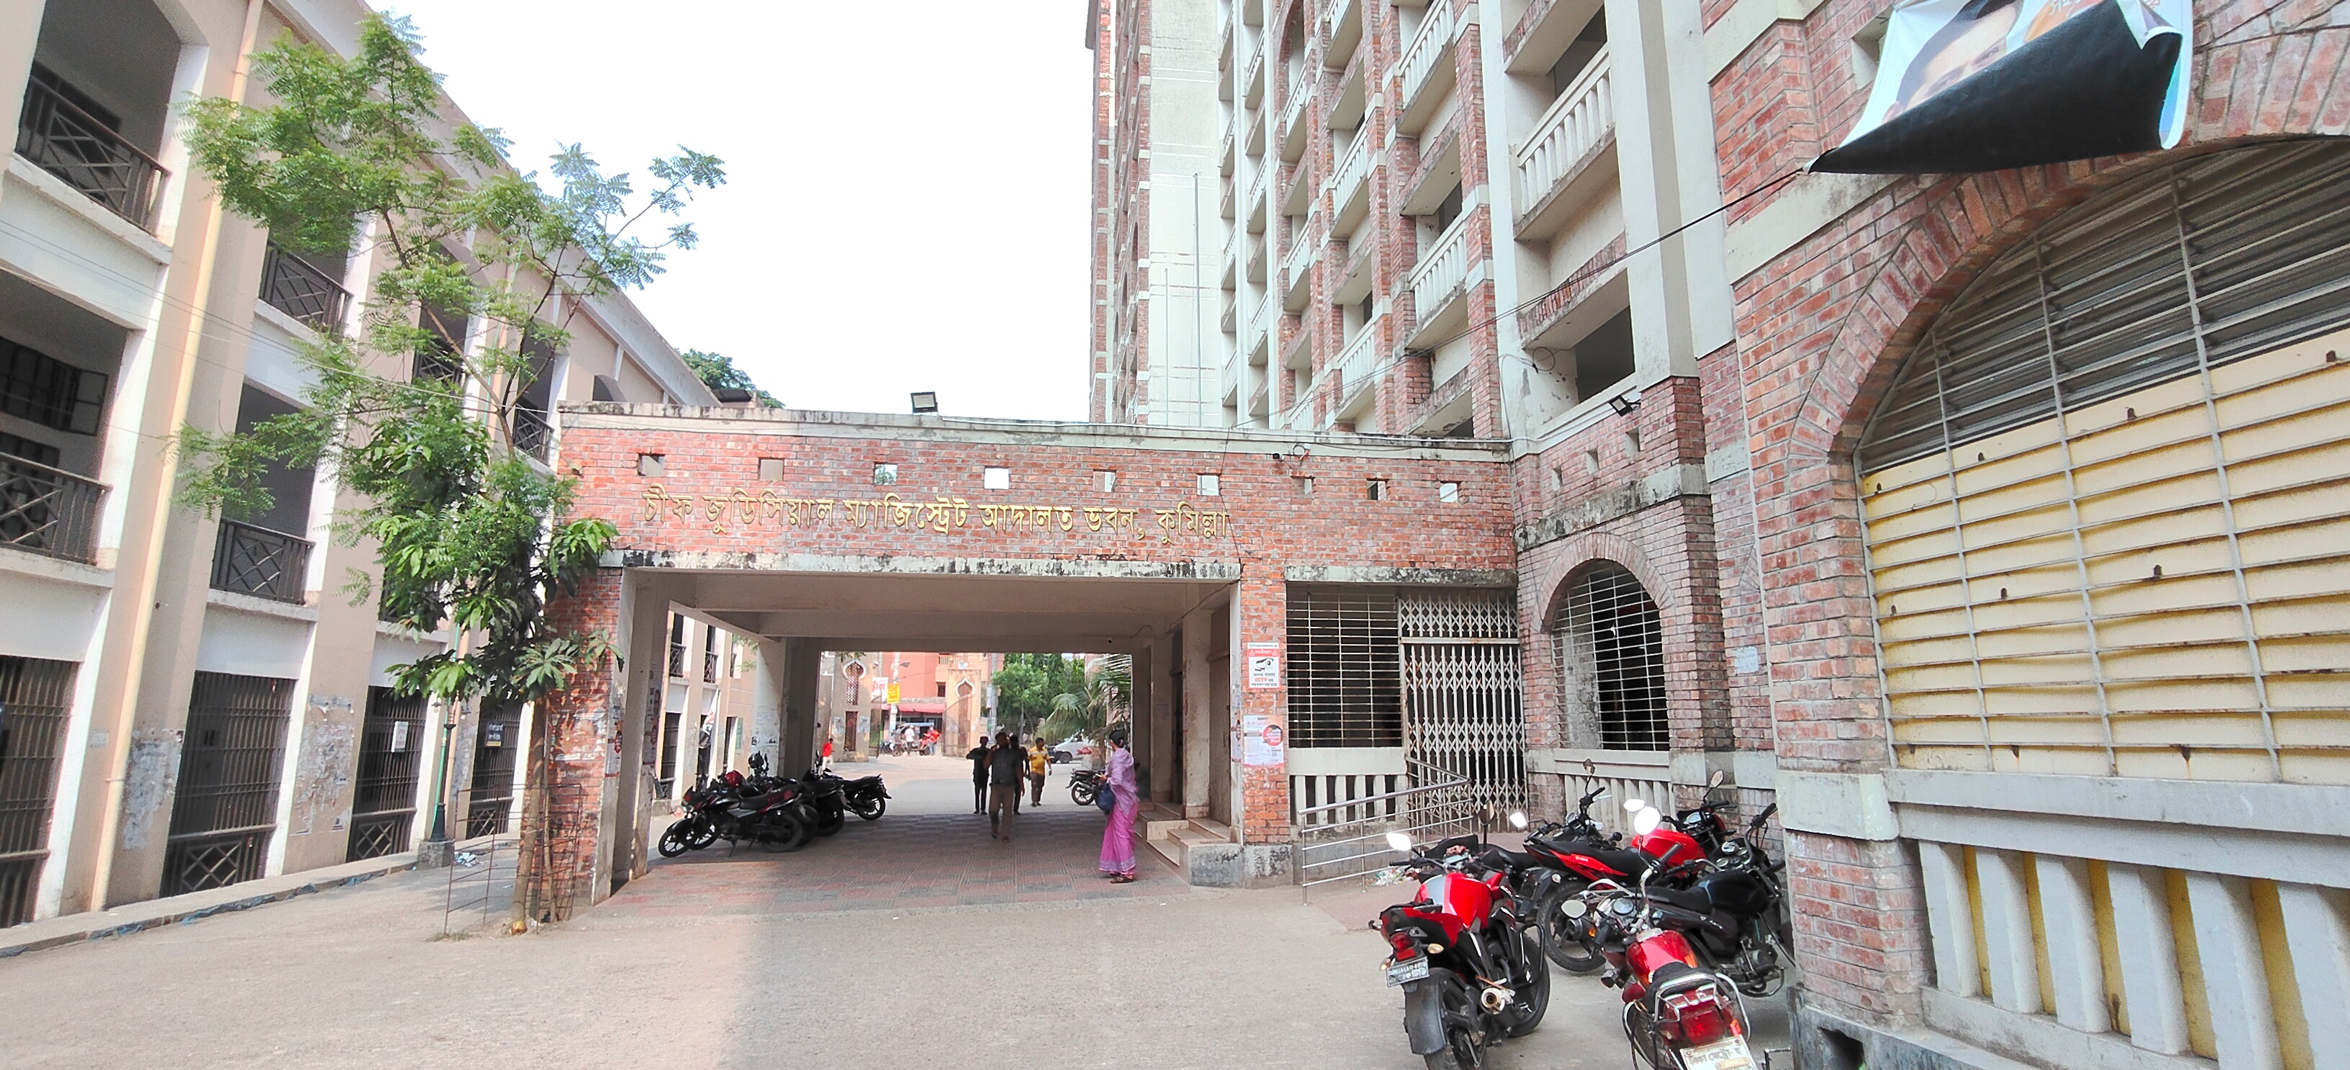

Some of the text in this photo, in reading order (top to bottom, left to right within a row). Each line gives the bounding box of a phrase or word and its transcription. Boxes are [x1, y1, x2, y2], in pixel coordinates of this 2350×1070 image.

[642, 483, 1231, 546] চীফ জুডিসিয়াল ম্যাজিস্ট্রেট আদালত ভবন, কুমিল্লা
